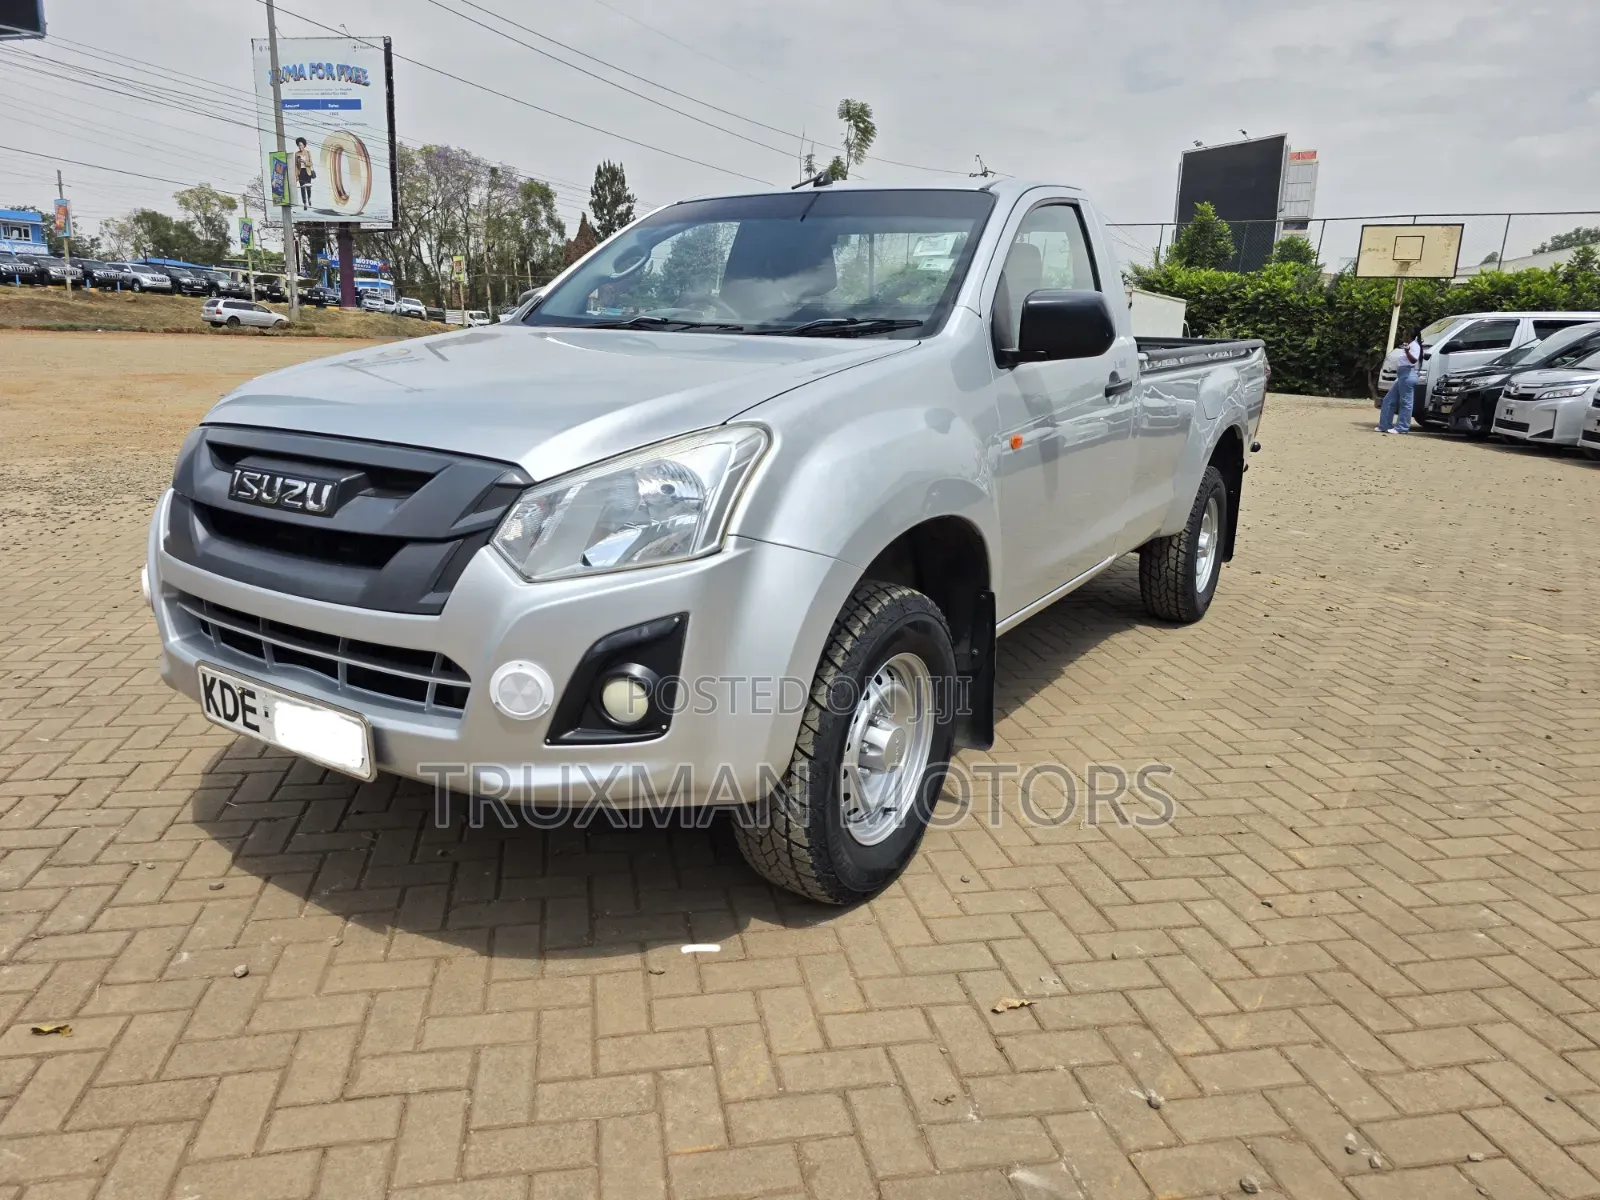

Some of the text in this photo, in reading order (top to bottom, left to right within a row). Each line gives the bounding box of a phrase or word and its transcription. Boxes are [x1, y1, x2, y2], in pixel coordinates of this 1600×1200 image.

[309, 62, 335, 81] FOR
[336, 63, 371, 87] FREE
[355, 257, 382, 266] MOTORS
[231, 469, 334, 512] ISUZU
[201, 672, 260, 733] KDE
